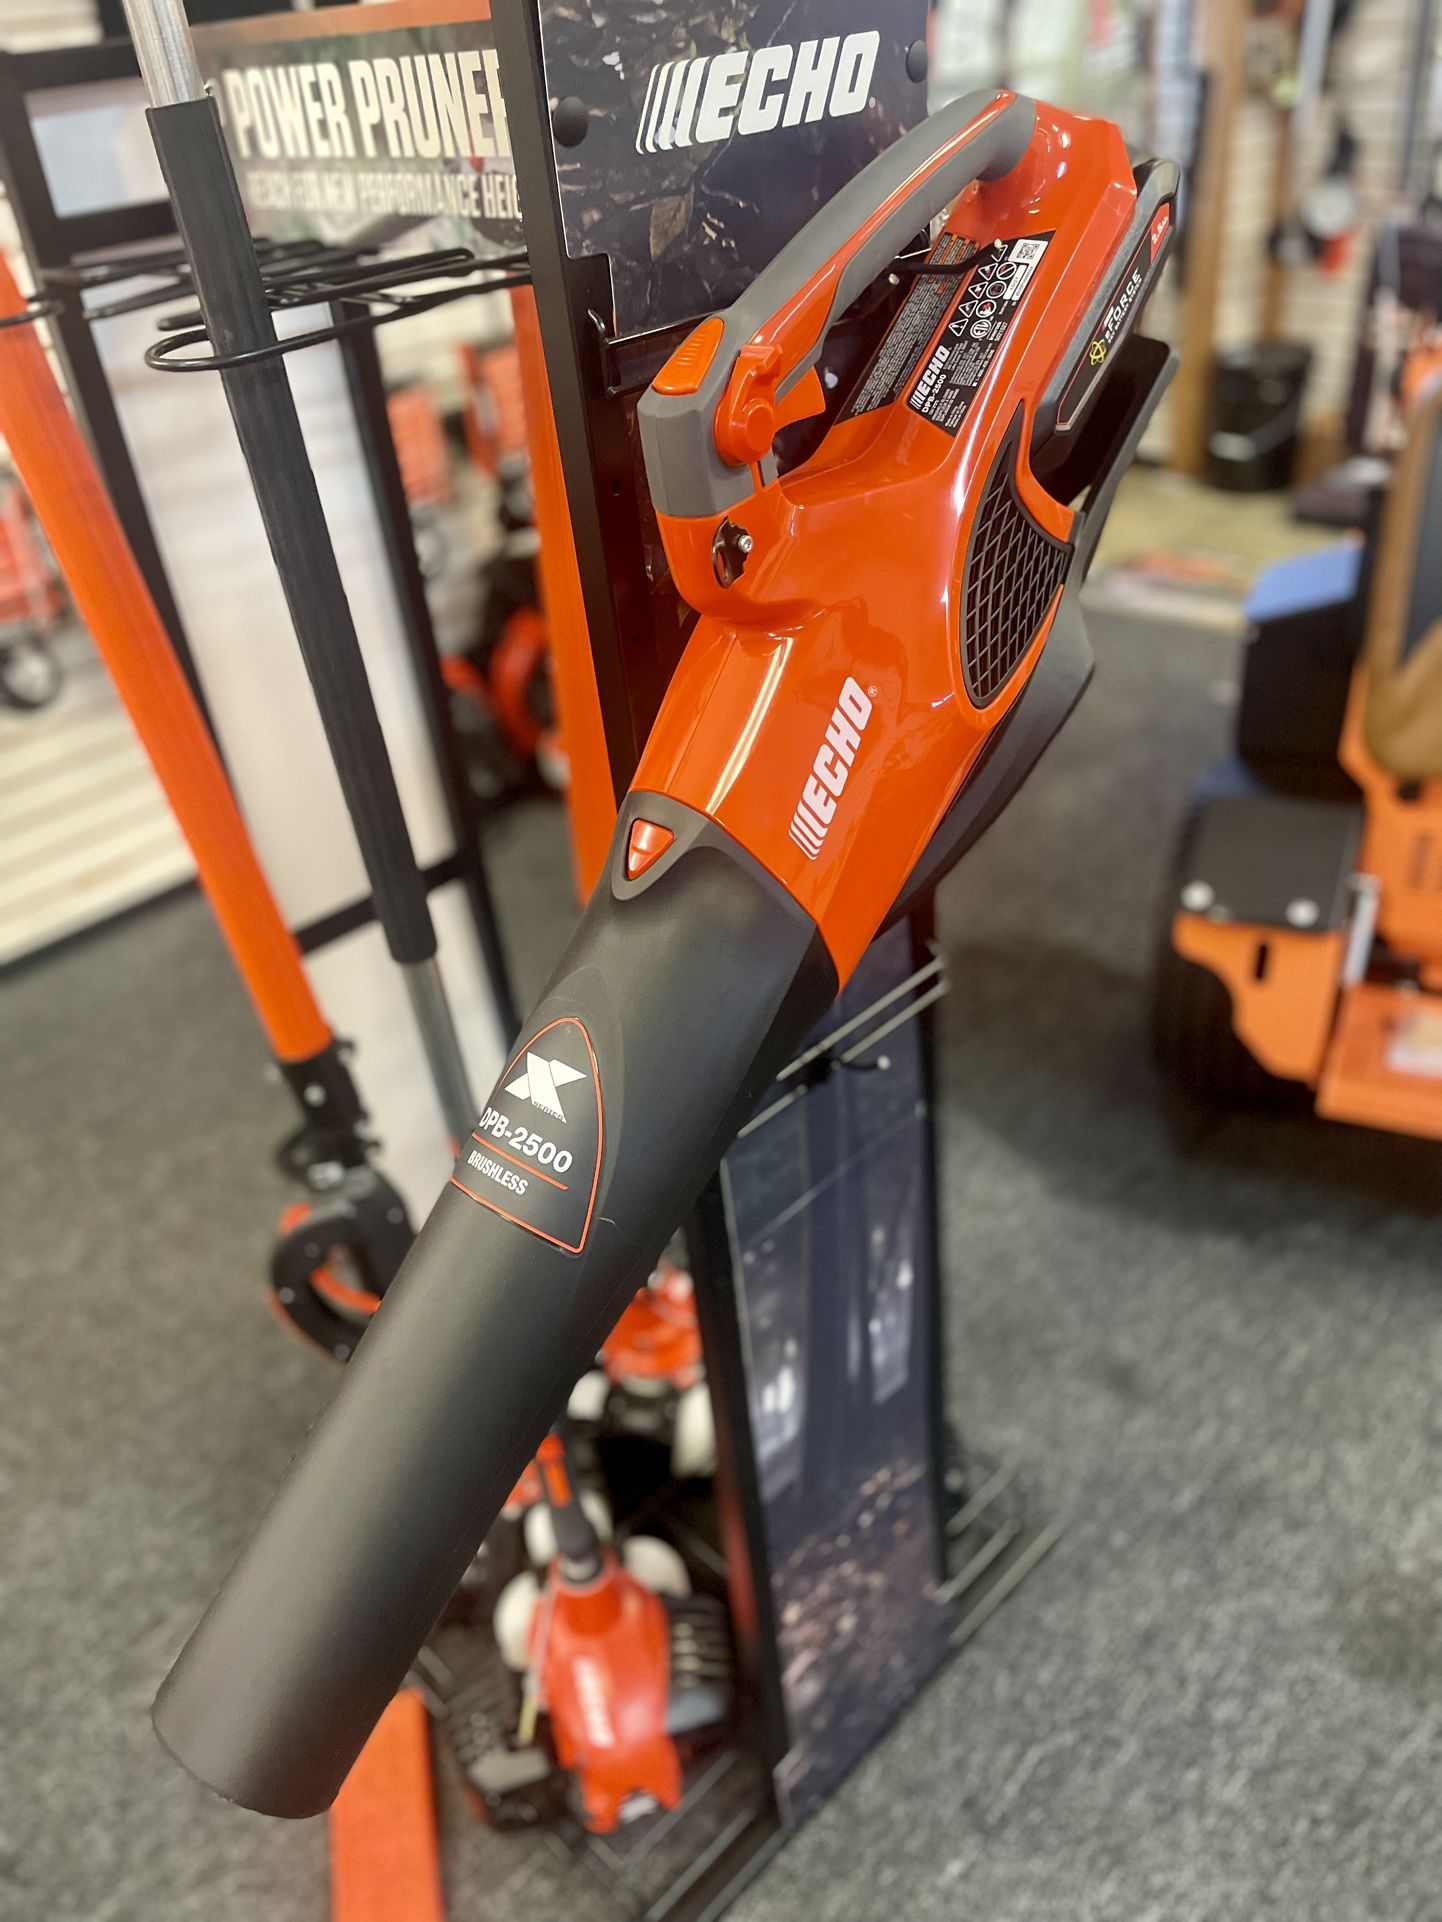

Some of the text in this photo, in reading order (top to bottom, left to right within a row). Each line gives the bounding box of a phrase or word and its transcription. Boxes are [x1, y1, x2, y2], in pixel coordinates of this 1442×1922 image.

[222, 62, 356, 159] POWER
[695, 30, 881, 144] ECHO
[918, 345, 950, 402] ECHO
[921, 374, 947, 413] DPB-2500
[802, 676, 873, 825] ECHO
[466, 1149, 529, 1196] BRUSHLESS
[478, 1106, 573, 1174] DPB-2500
